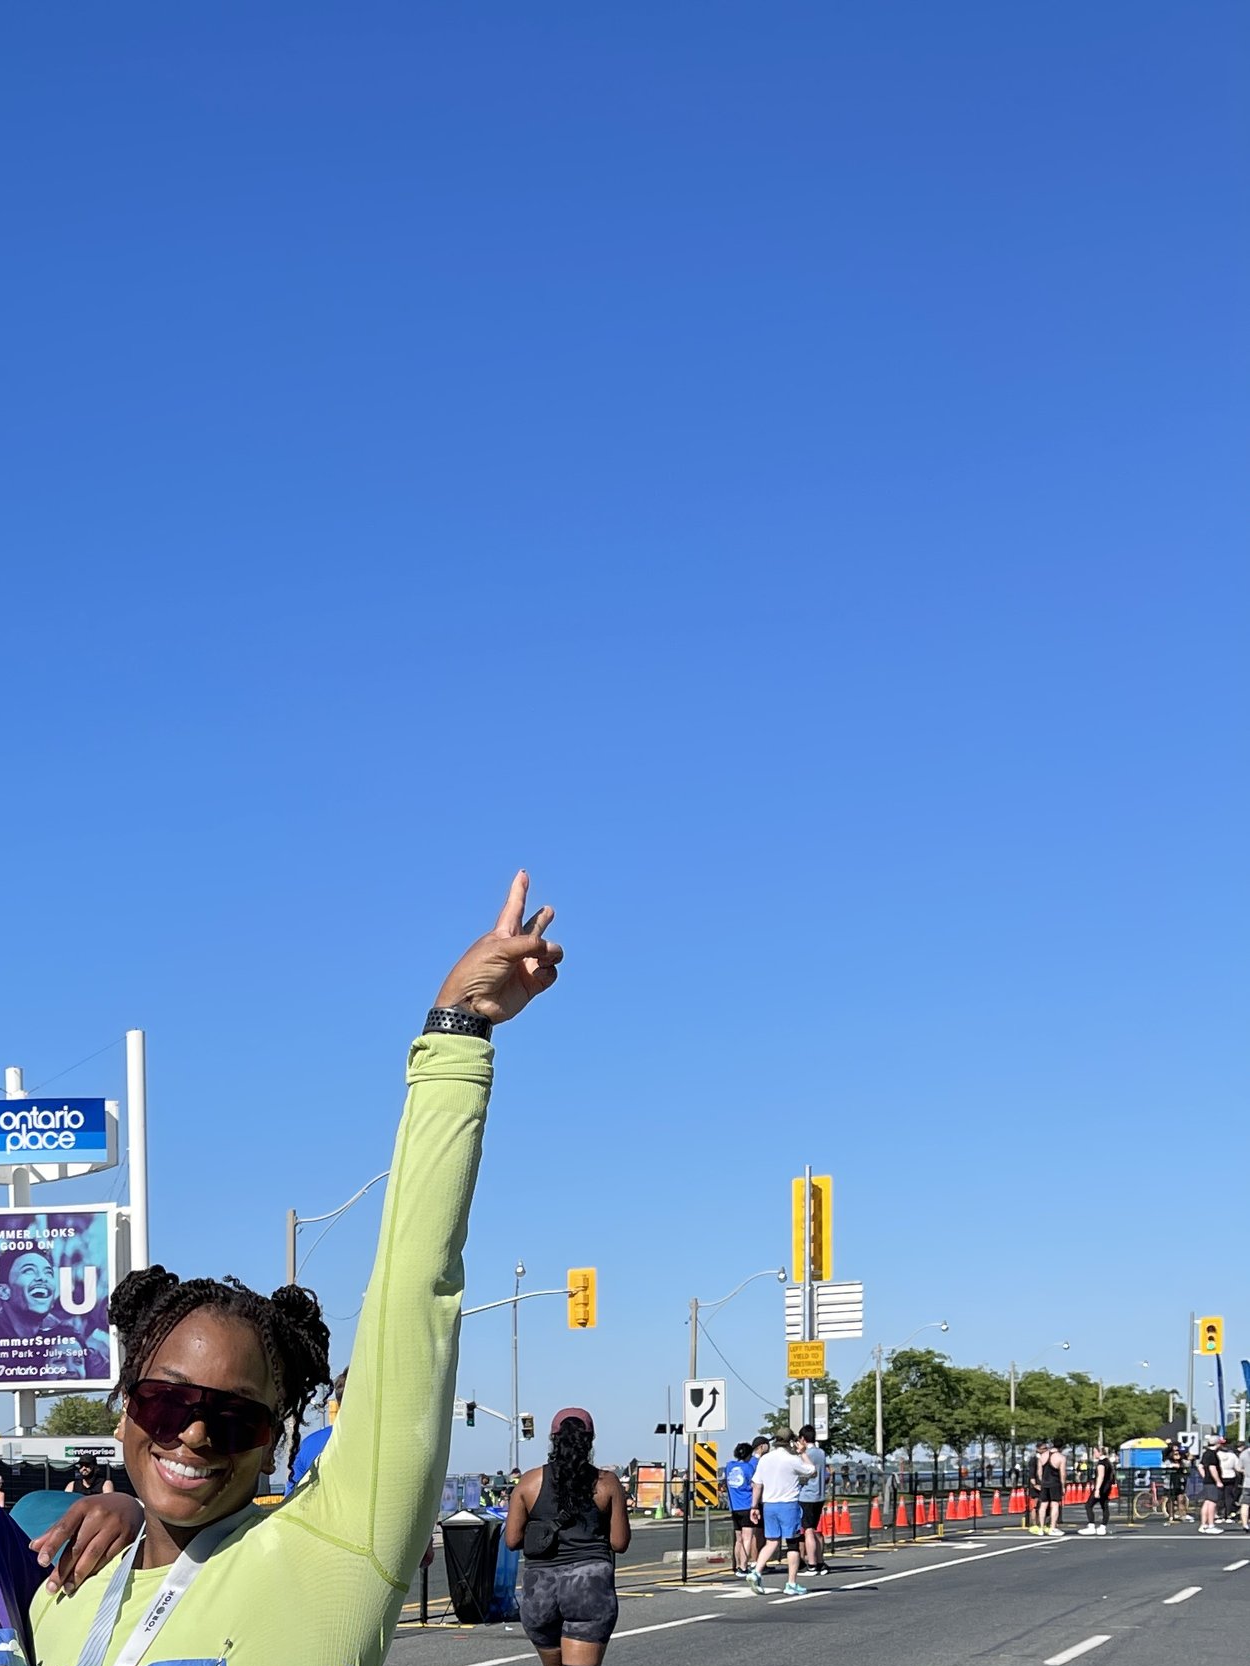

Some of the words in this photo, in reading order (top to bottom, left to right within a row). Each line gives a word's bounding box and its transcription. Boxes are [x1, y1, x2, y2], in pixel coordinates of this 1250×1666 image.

[0, 1105, 84, 1130] ontario
[6, 1119, 76, 1155] place
[36, 1228, 75, 1238] LOOKS
[0, 1241, 33, 1250] GOOD
[38, 1240, 54, 1250] ON
[12, 1349, 34, 1358] Park
[5, 1365, 38, 1376] ontario
[39, 1364, 67, 1376] place
[67, 1447, 115, 1458] enterprise
